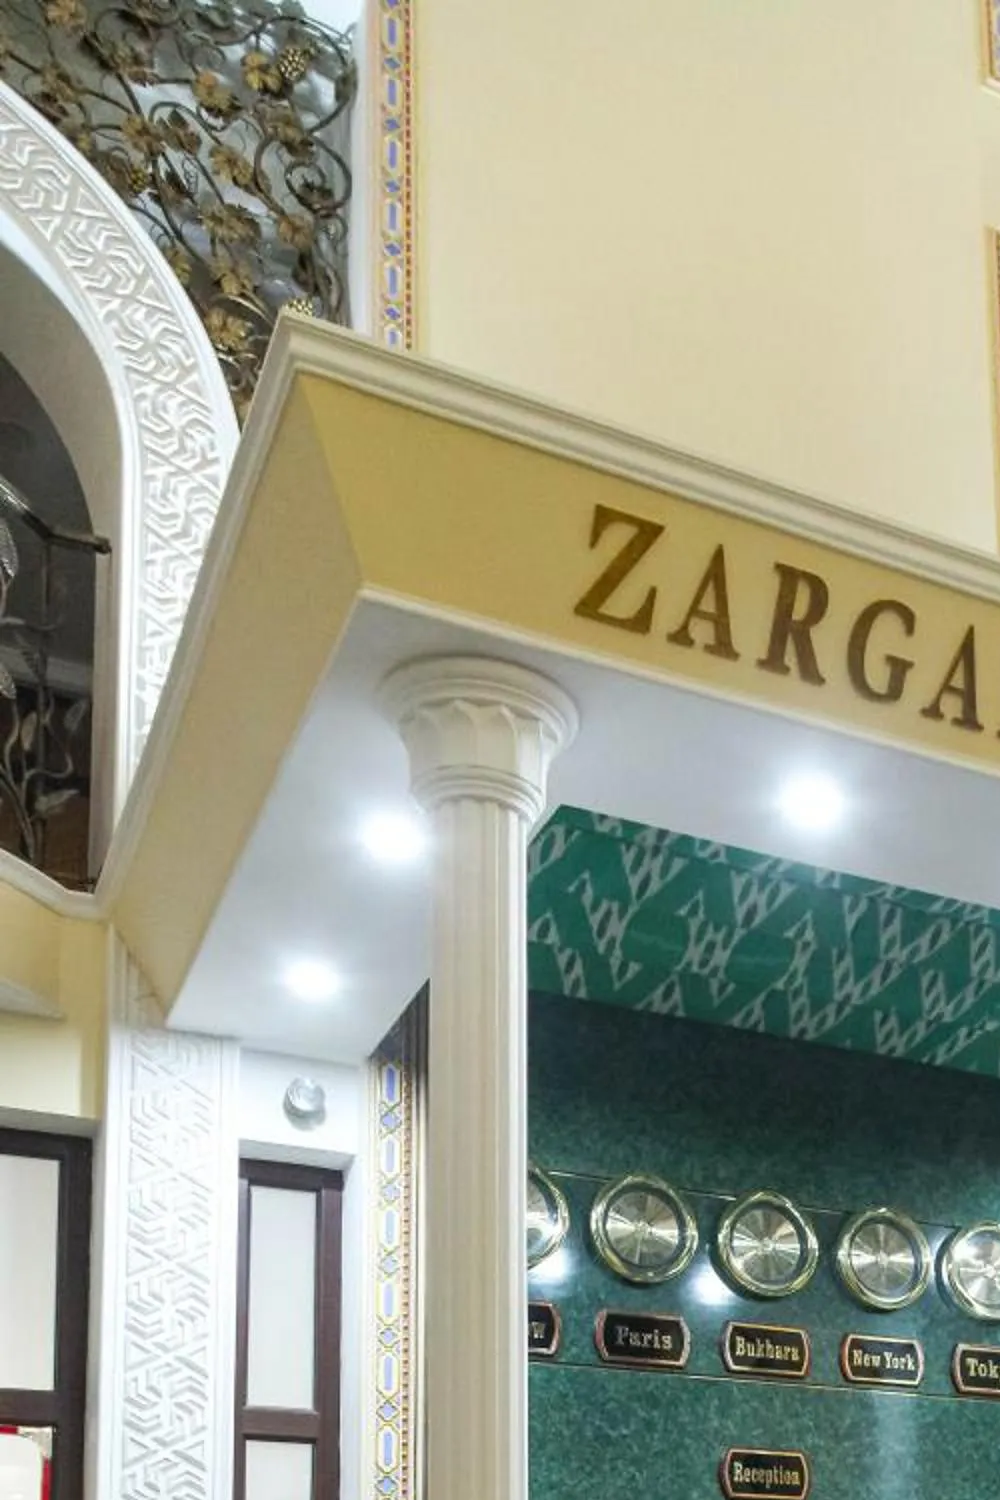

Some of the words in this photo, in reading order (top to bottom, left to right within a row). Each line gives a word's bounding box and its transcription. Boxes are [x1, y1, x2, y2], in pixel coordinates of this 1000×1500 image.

[615, 1325, 674, 1350] Paris
[735, 1336, 800, 1362] Bukhara
[852, 1349, 881, 1368] New
[884, 1351, 916, 1371] York
[733, 1461, 801, 1490] Reception
